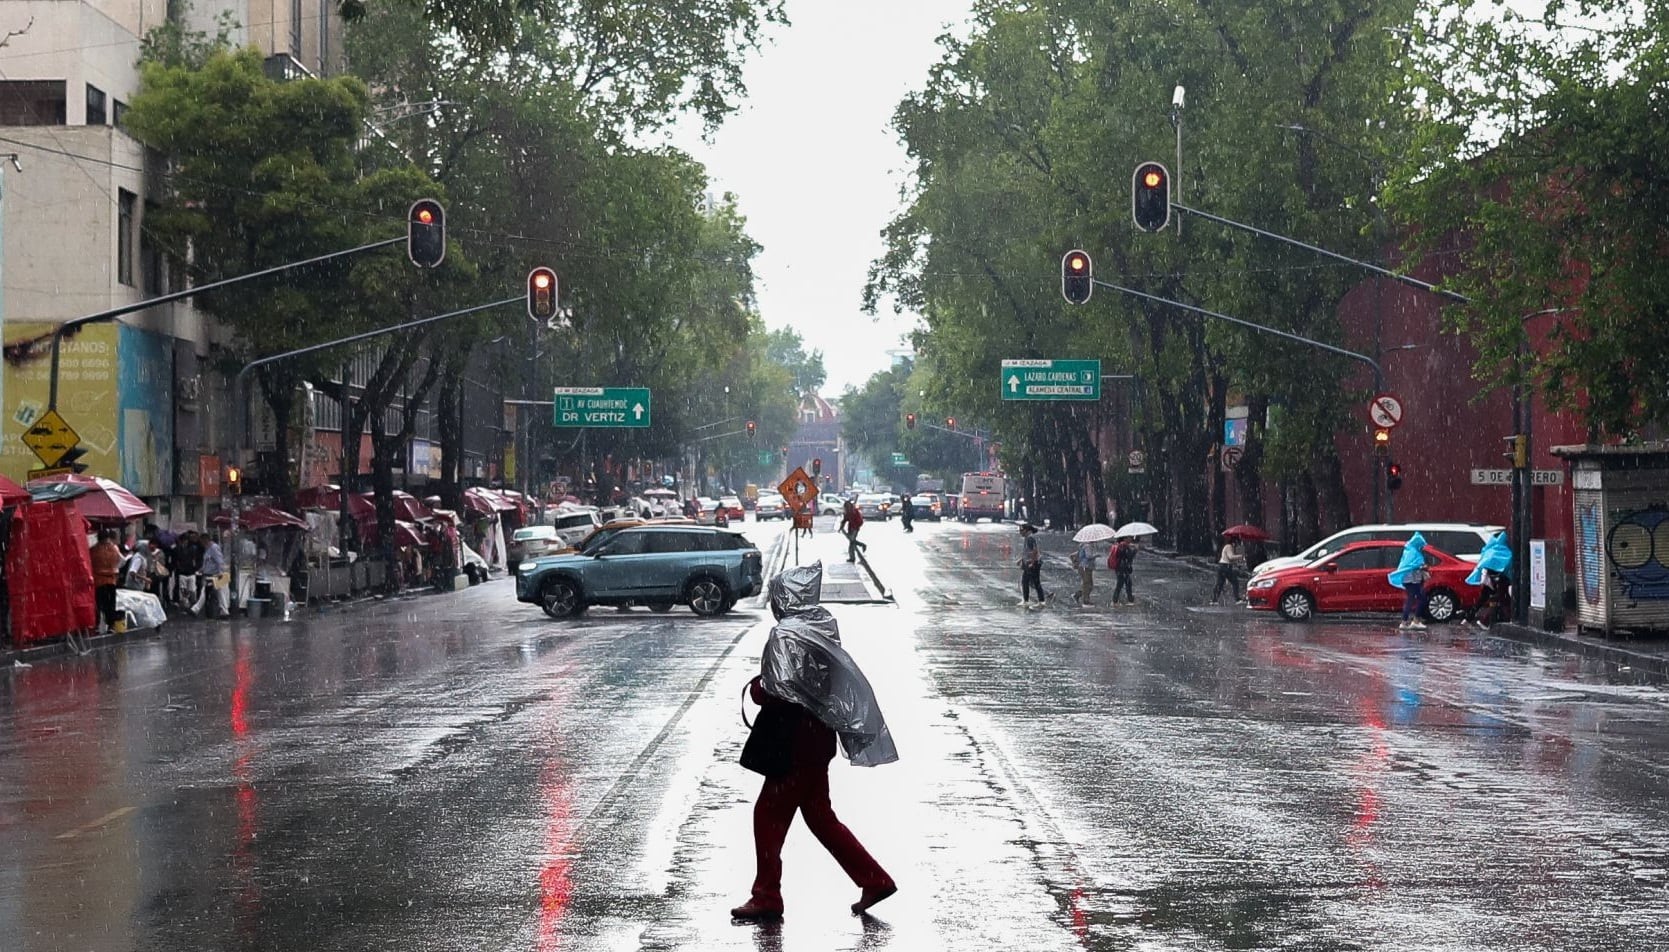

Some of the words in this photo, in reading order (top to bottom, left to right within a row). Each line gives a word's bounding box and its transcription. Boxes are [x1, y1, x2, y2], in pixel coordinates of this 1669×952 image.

[577, 400, 585, 409] AV
[562, 412, 578, 421] DR
[584, 412, 625, 421] VERTIZ
[1478, 471, 1485, 482] 5
[1489, 471, 1504, 482] DE
[1508, 471, 1557, 483] FRERO
